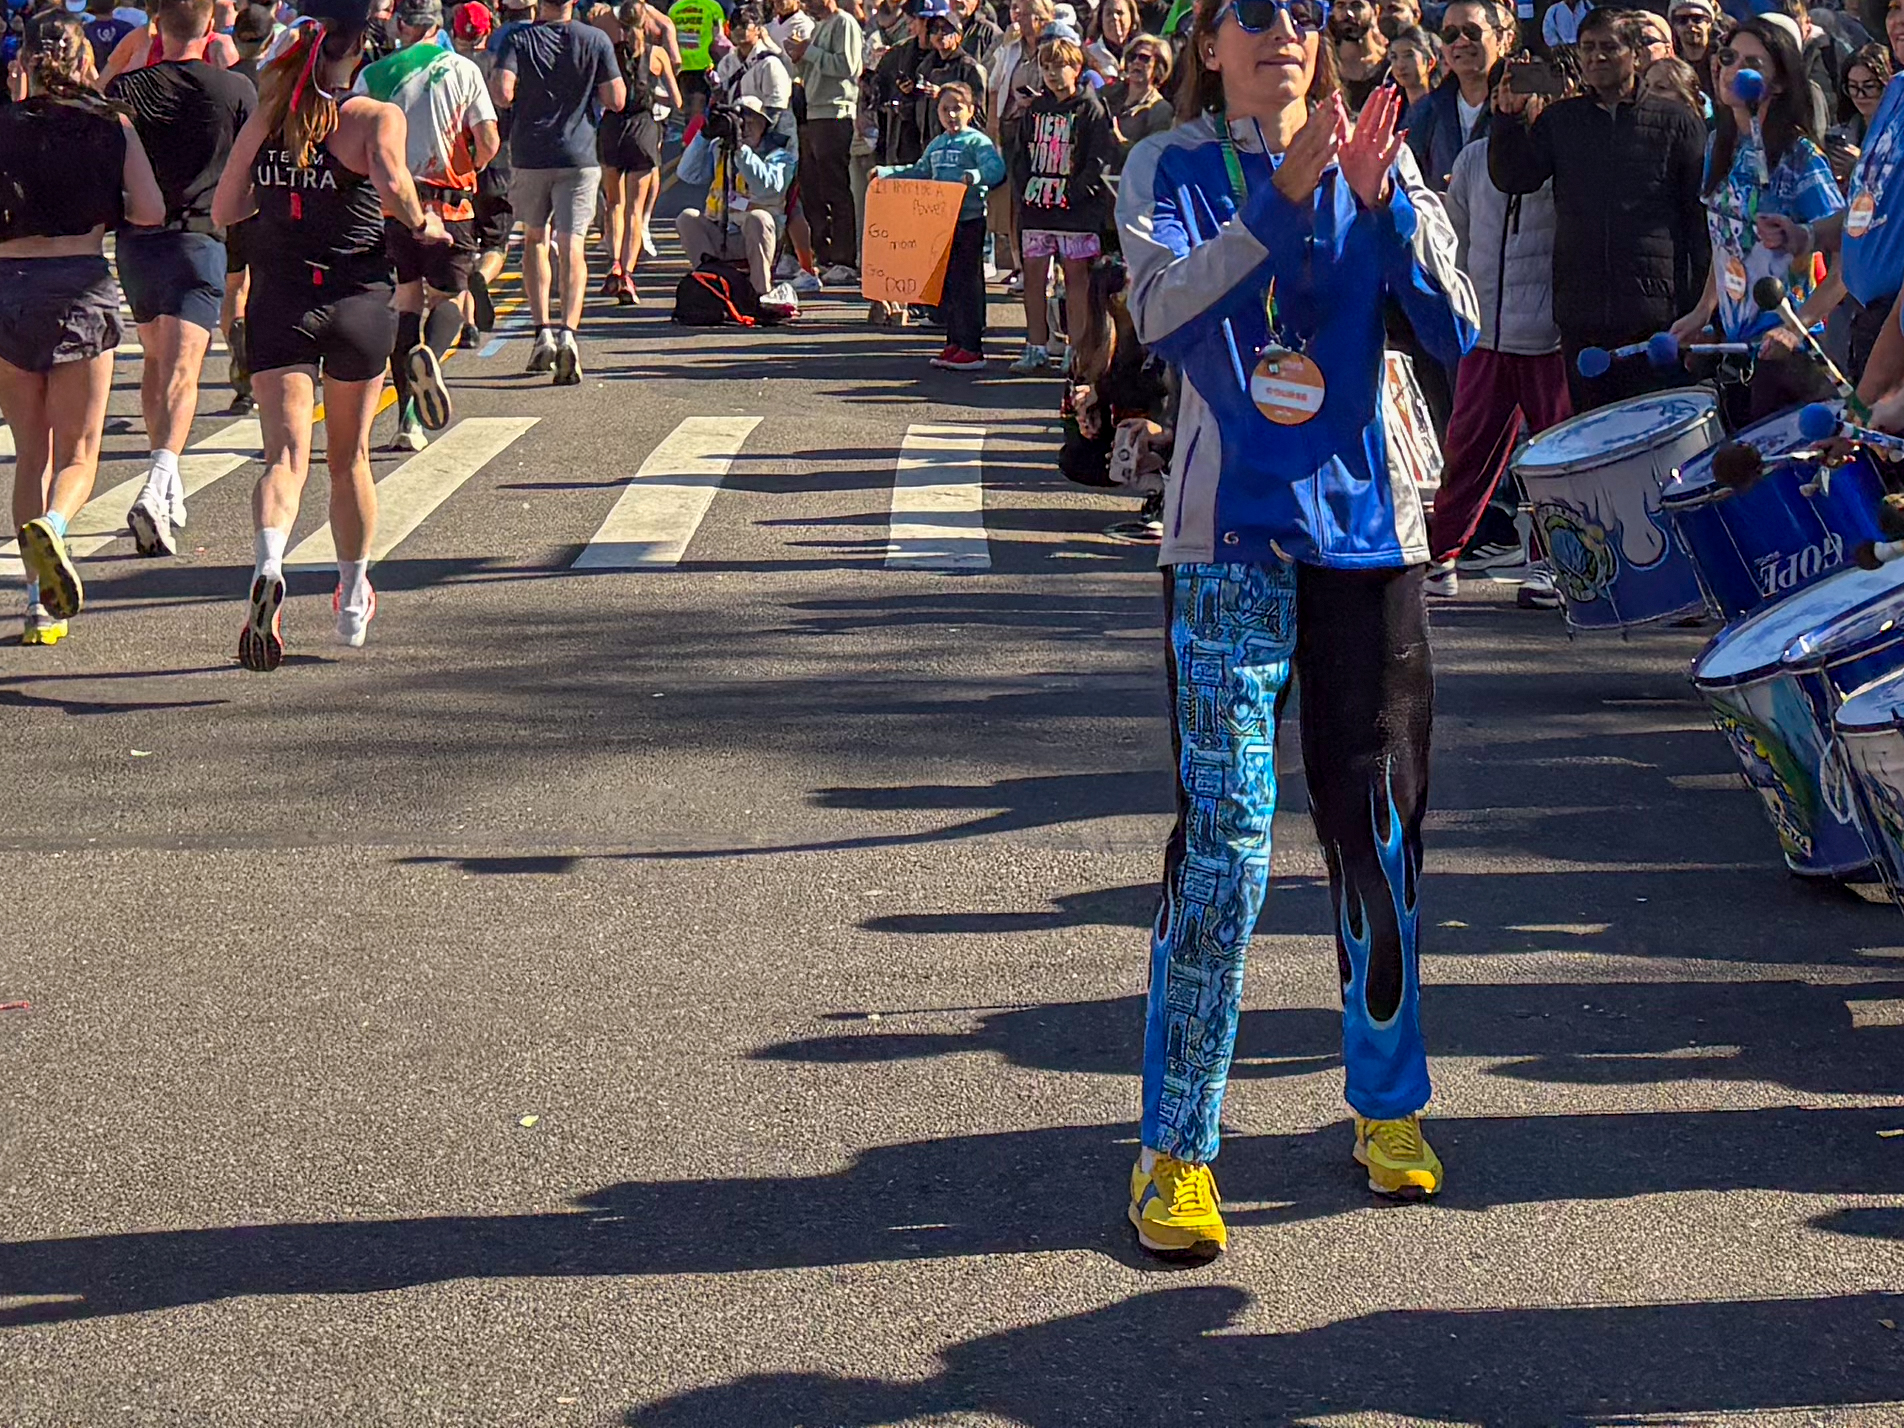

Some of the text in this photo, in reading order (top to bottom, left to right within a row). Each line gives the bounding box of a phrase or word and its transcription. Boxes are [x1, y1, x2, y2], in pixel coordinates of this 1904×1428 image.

[257, 164, 338, 191] ULTRA
[868, 223, 889, 239] Go
[885, 276, 916, 294] DAD
